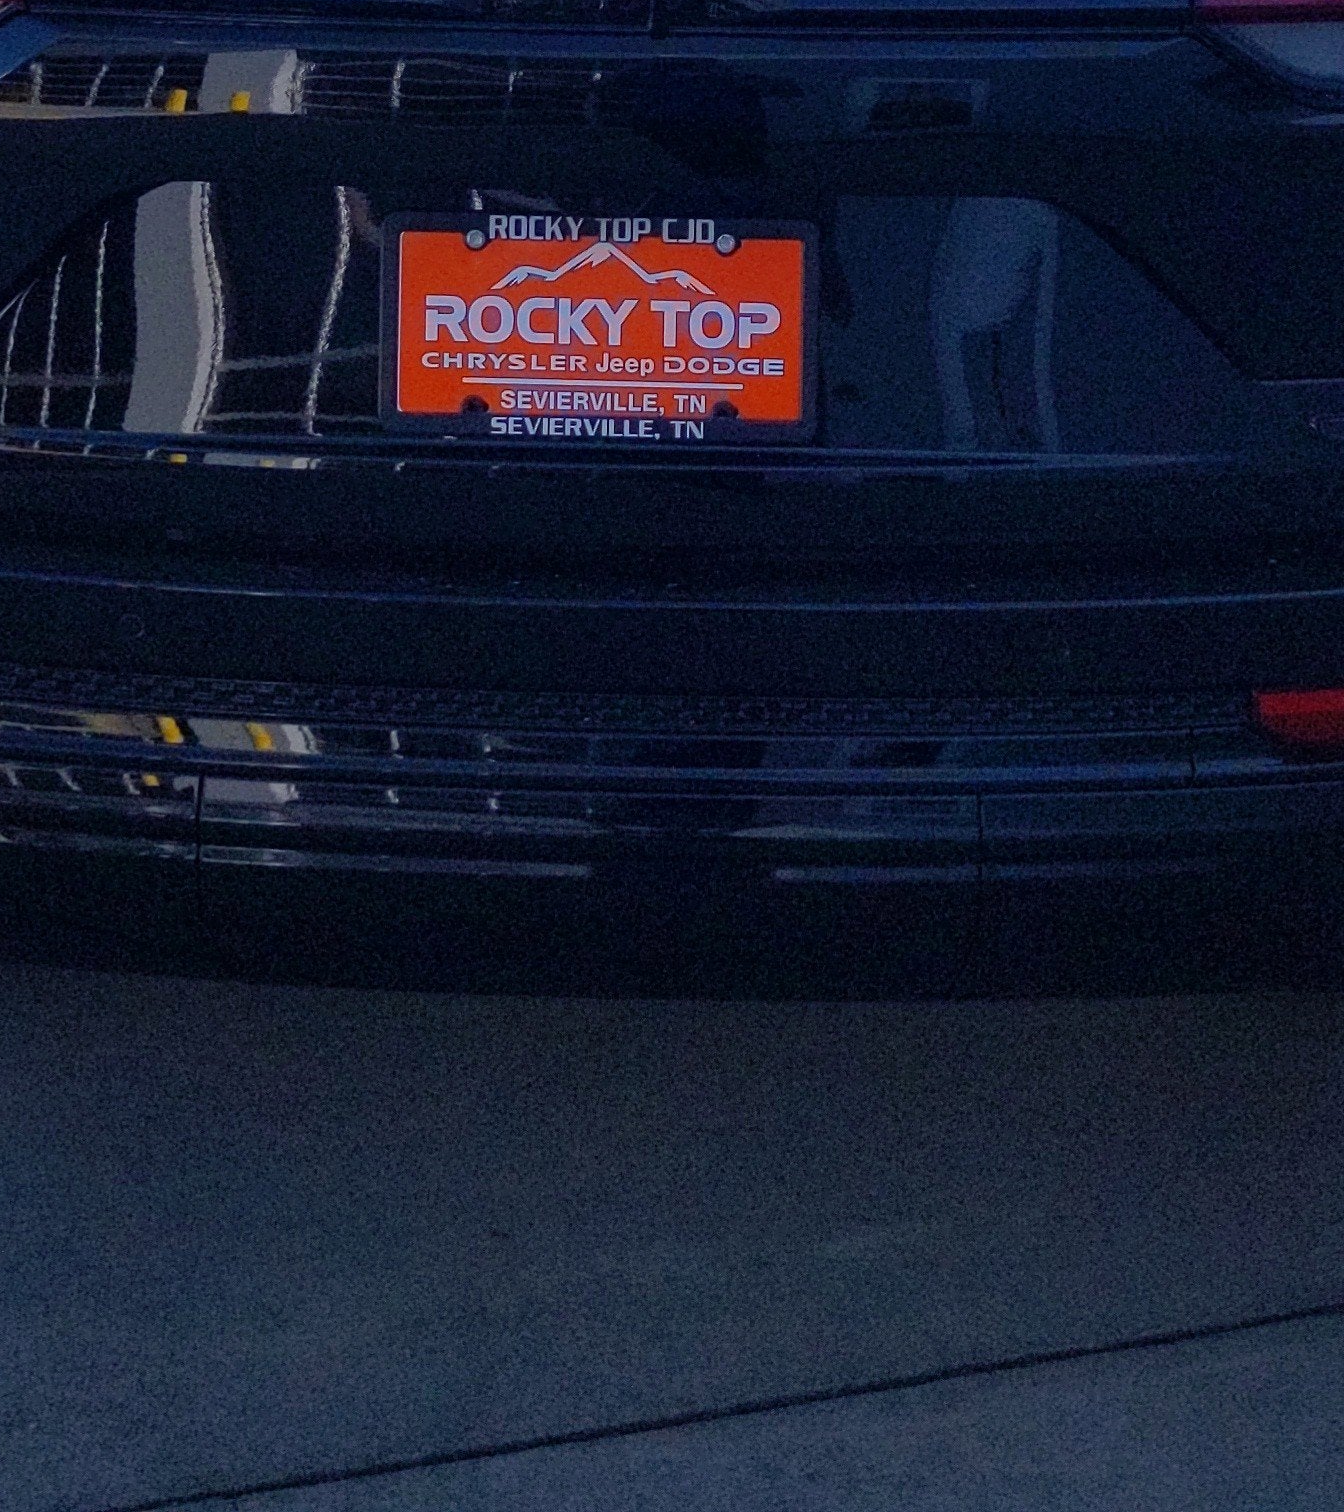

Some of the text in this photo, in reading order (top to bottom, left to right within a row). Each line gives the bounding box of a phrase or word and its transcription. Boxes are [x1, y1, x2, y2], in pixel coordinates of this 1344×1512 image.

[488, 214, 715, 244] ROCKY TOP CJD
[425, 294, 781, 349] ROCKY TOP
[421, 351, 784, 377] CHRYSLER Jeep DODGE
[500, 390, 706, 416] SEVIERVILLE, TN
[490, 416, 704, 439] SEVIERVILLE, TN
